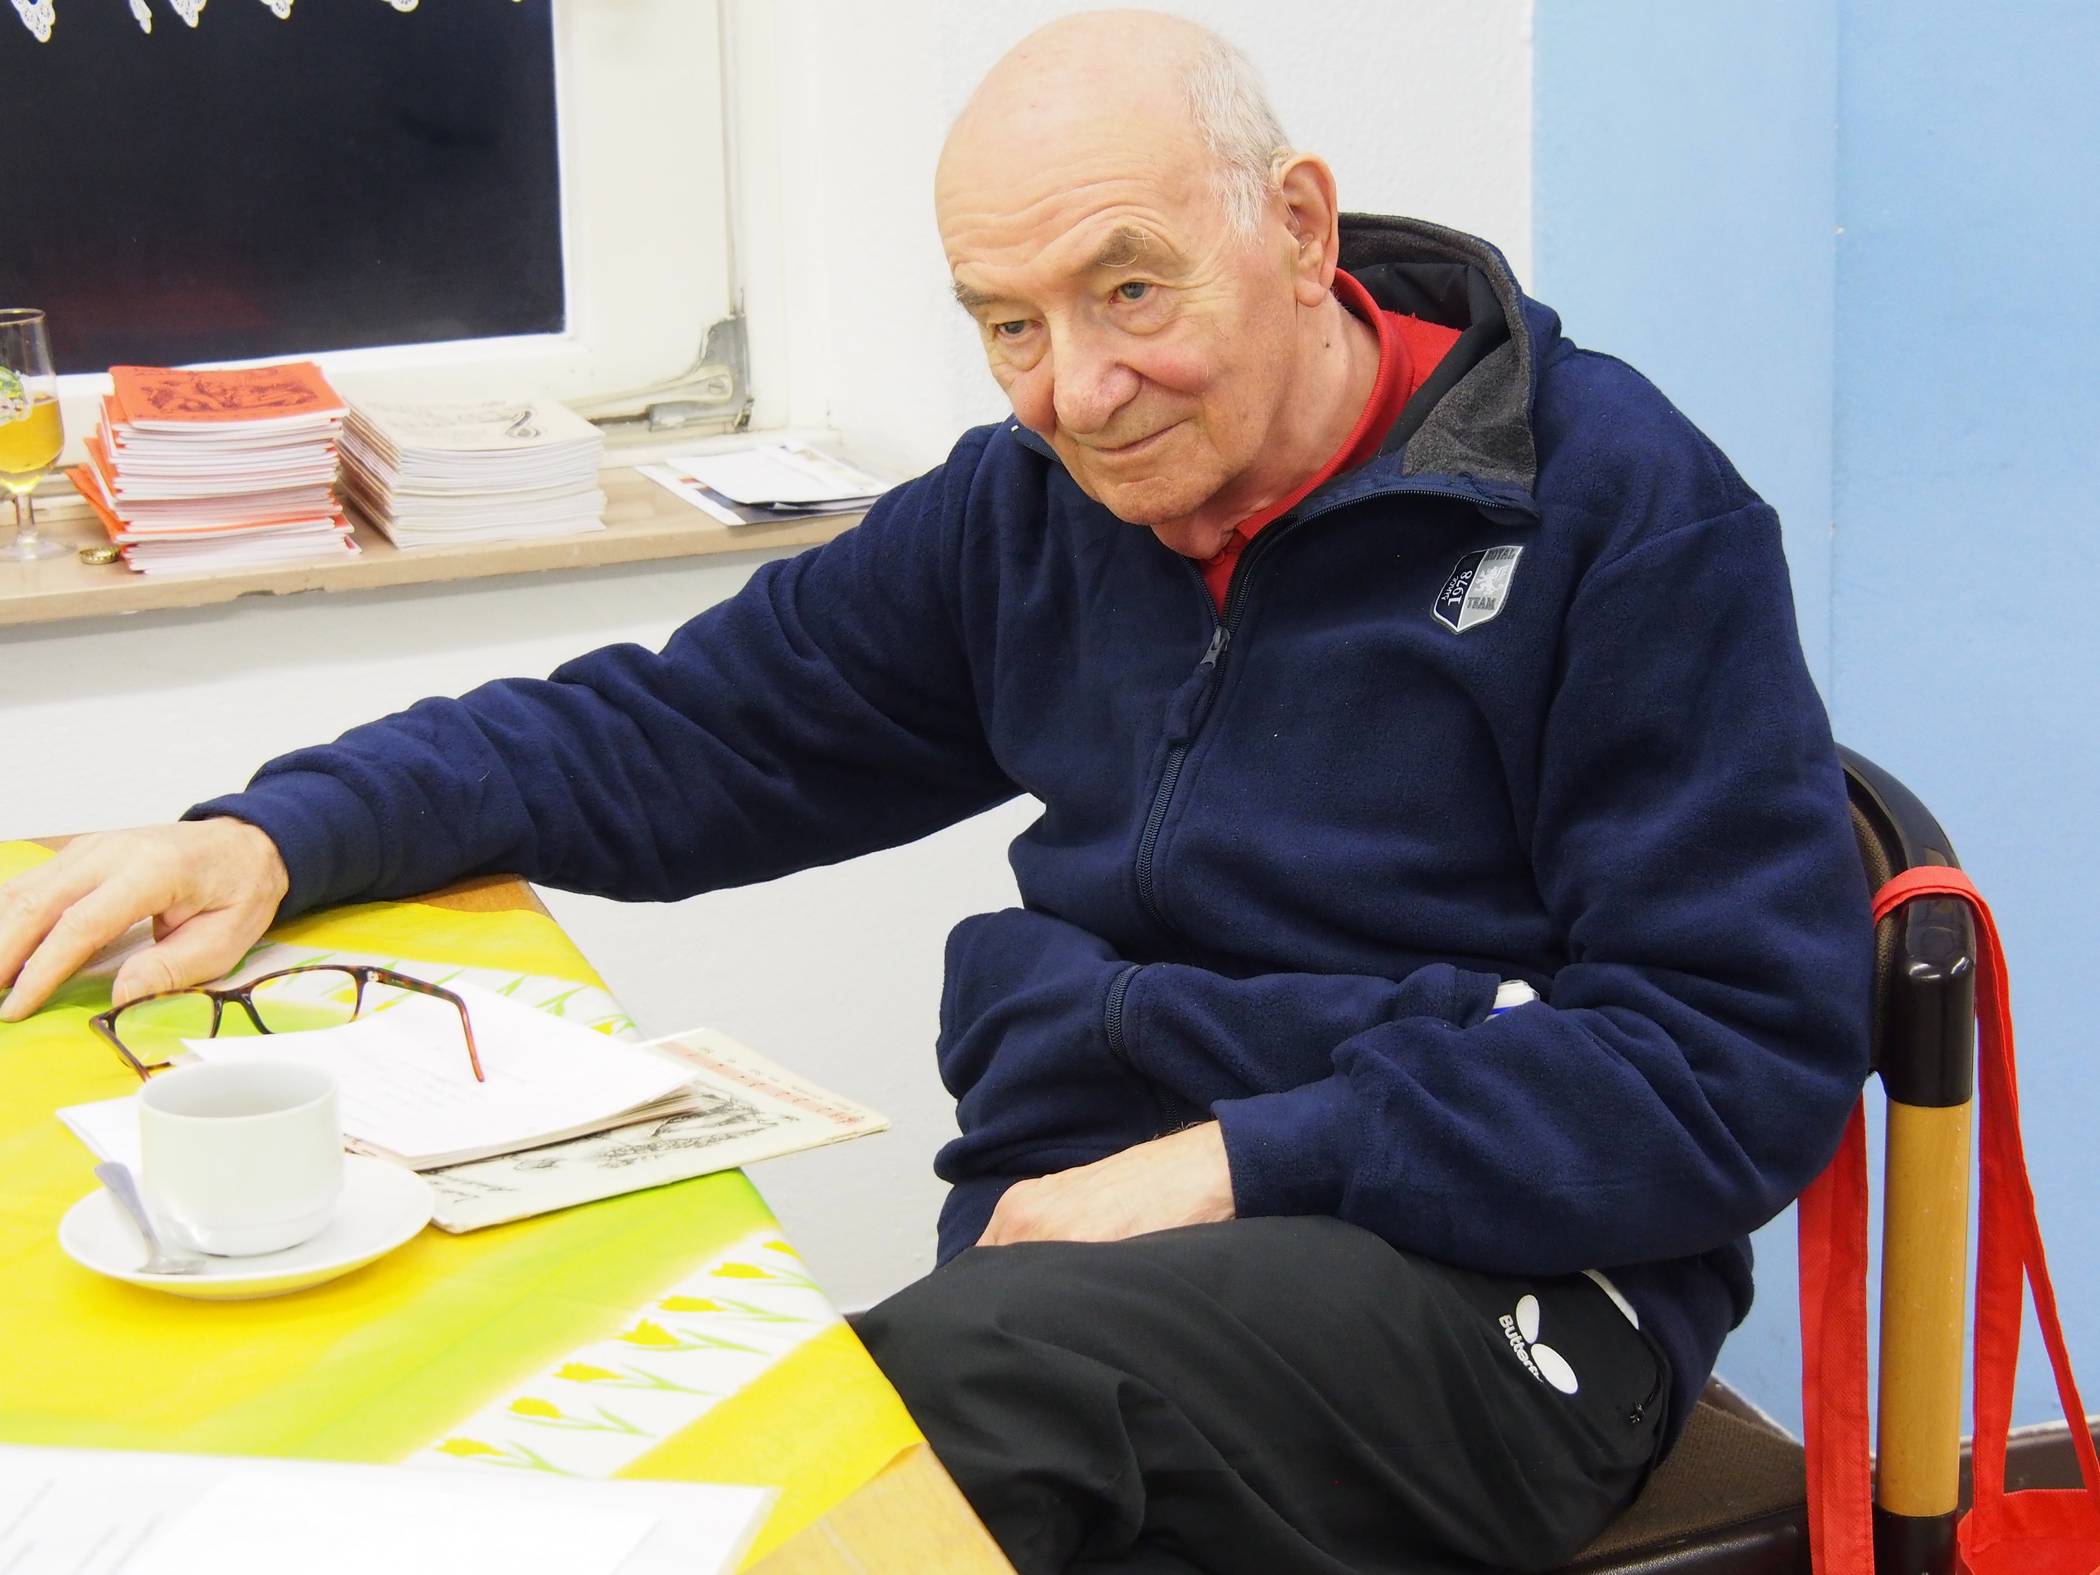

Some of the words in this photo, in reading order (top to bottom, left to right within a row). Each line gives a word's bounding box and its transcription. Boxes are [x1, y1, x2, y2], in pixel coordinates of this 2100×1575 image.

[1447, 570, 1473, 606] 1978
[1467, 597, 1496, 610] TEAM
[1498, 1314, 1545, 1384] Butter
